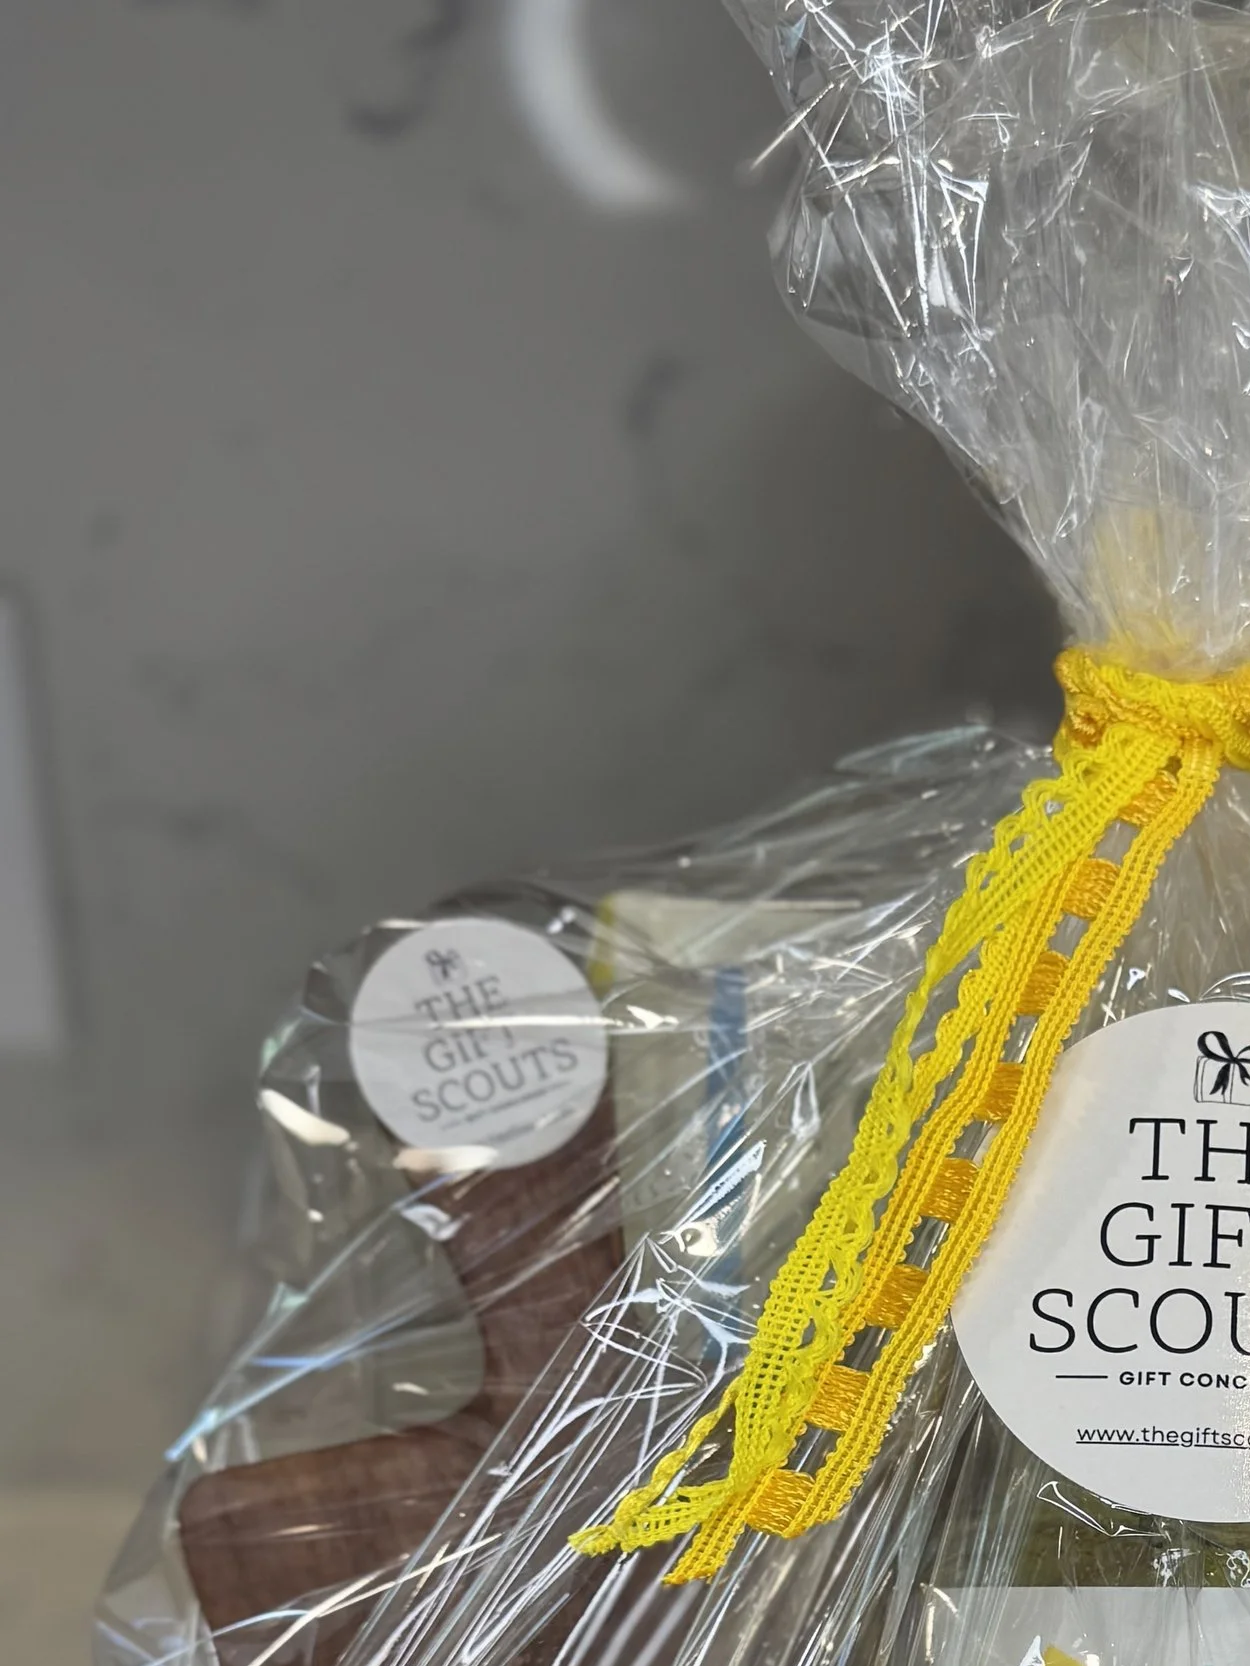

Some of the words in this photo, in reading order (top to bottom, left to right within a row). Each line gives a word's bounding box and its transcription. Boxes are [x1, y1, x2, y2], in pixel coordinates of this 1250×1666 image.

[413, 975, 510, 1030] THE
[410, 1037, 581, 1123] SCOUTS
[1118, 1370, 1172, 1387] GIFT
